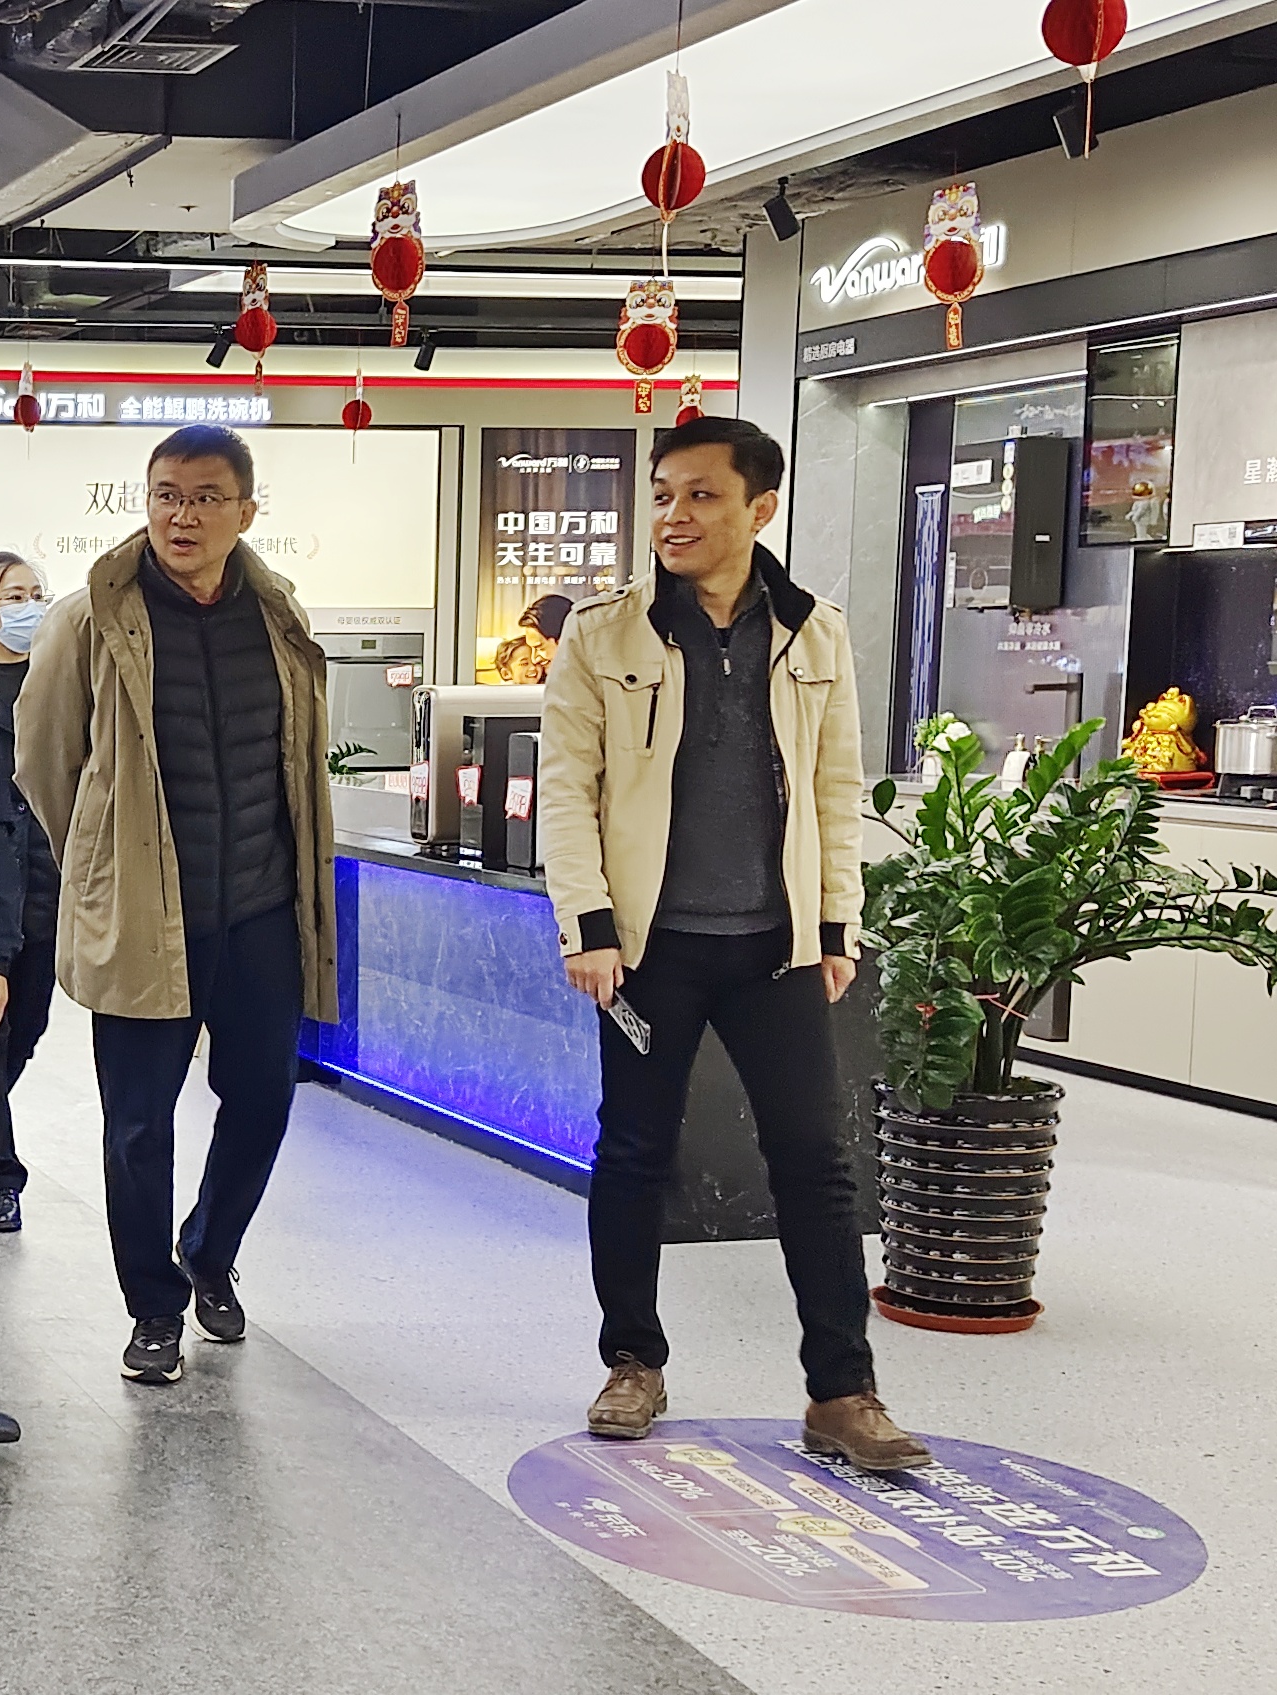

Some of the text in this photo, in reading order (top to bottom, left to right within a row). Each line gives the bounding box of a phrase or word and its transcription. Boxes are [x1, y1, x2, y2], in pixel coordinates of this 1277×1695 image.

[810, 236, 925, 303] Vanwar
[47, 392, 106, 419] 万和
[120, 396, 272, 421] 全能鲲鹏洗碗机
[497, 510, 619, 535] 中国万和
[496, 542, 617, 566] 天生可靠
[593, 1513, 647, 1537] 京东
[980, 1551, 1047, 1582] 40%
